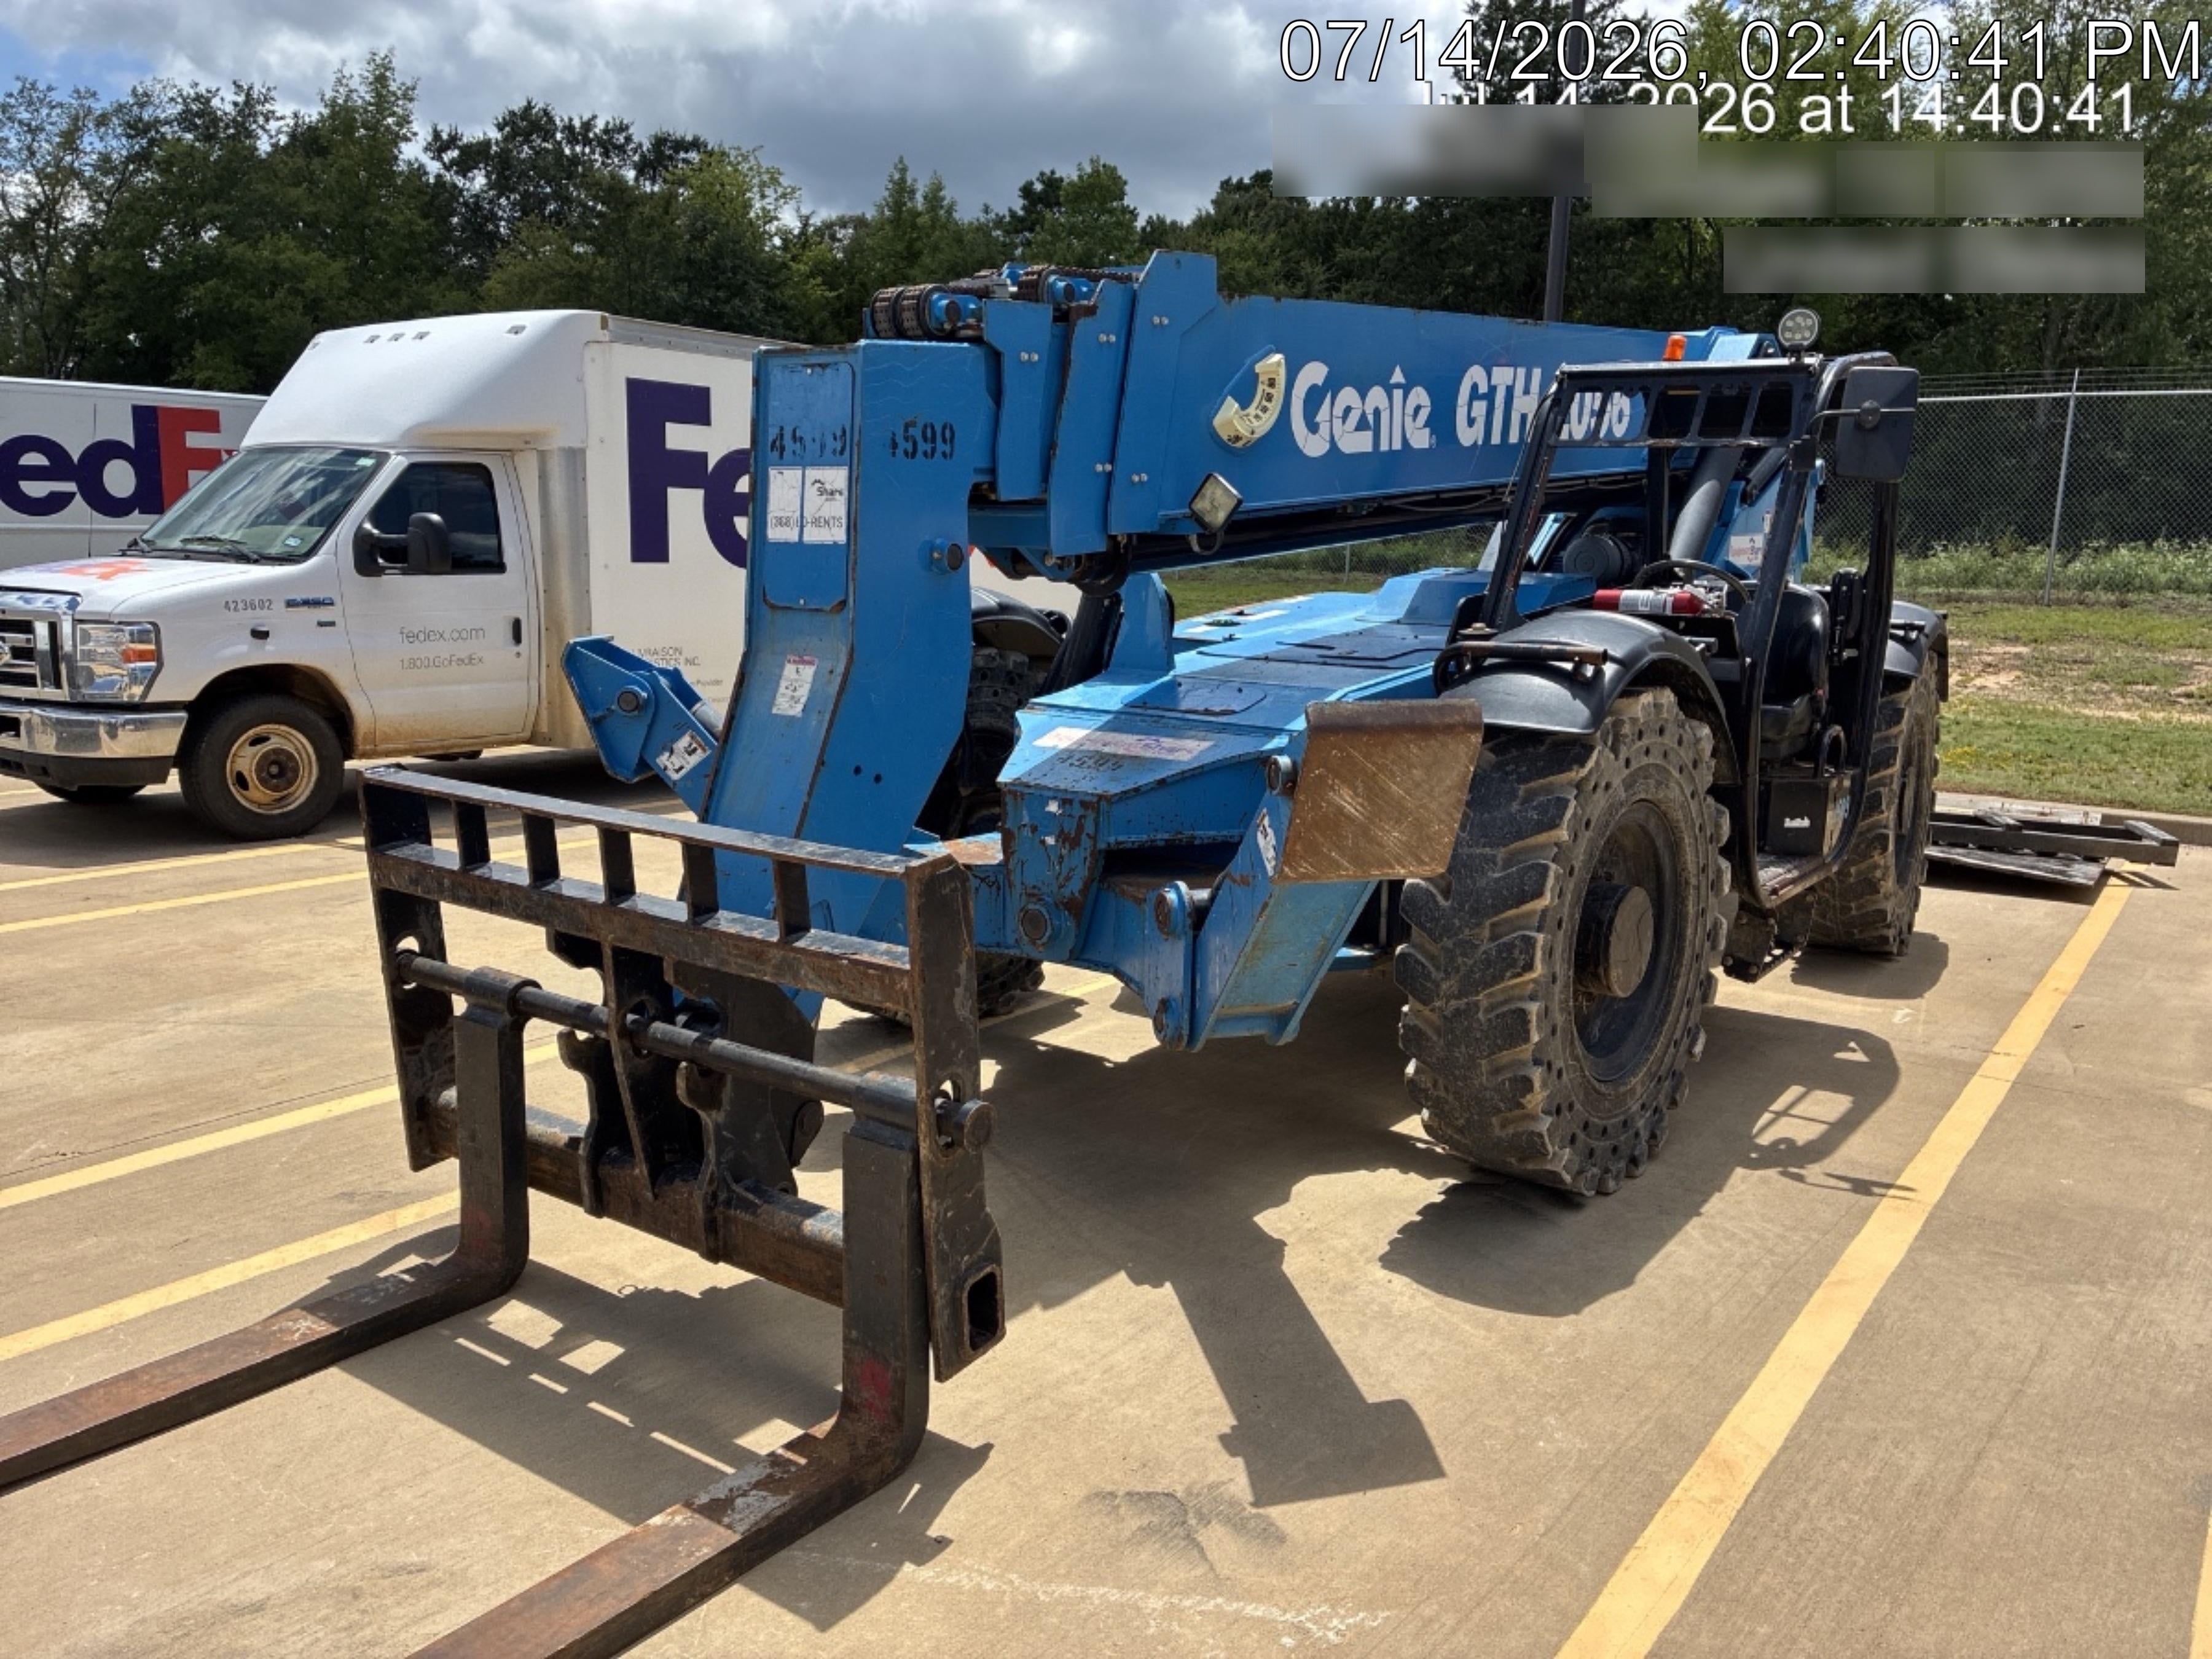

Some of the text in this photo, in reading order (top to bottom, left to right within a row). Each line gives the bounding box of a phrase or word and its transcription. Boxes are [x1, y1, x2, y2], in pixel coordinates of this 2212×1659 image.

[1291, 360, 1432, 458] Genie
[224, 598, 273, 613] 423602
[399, 626, 485, 644] fedex.com
